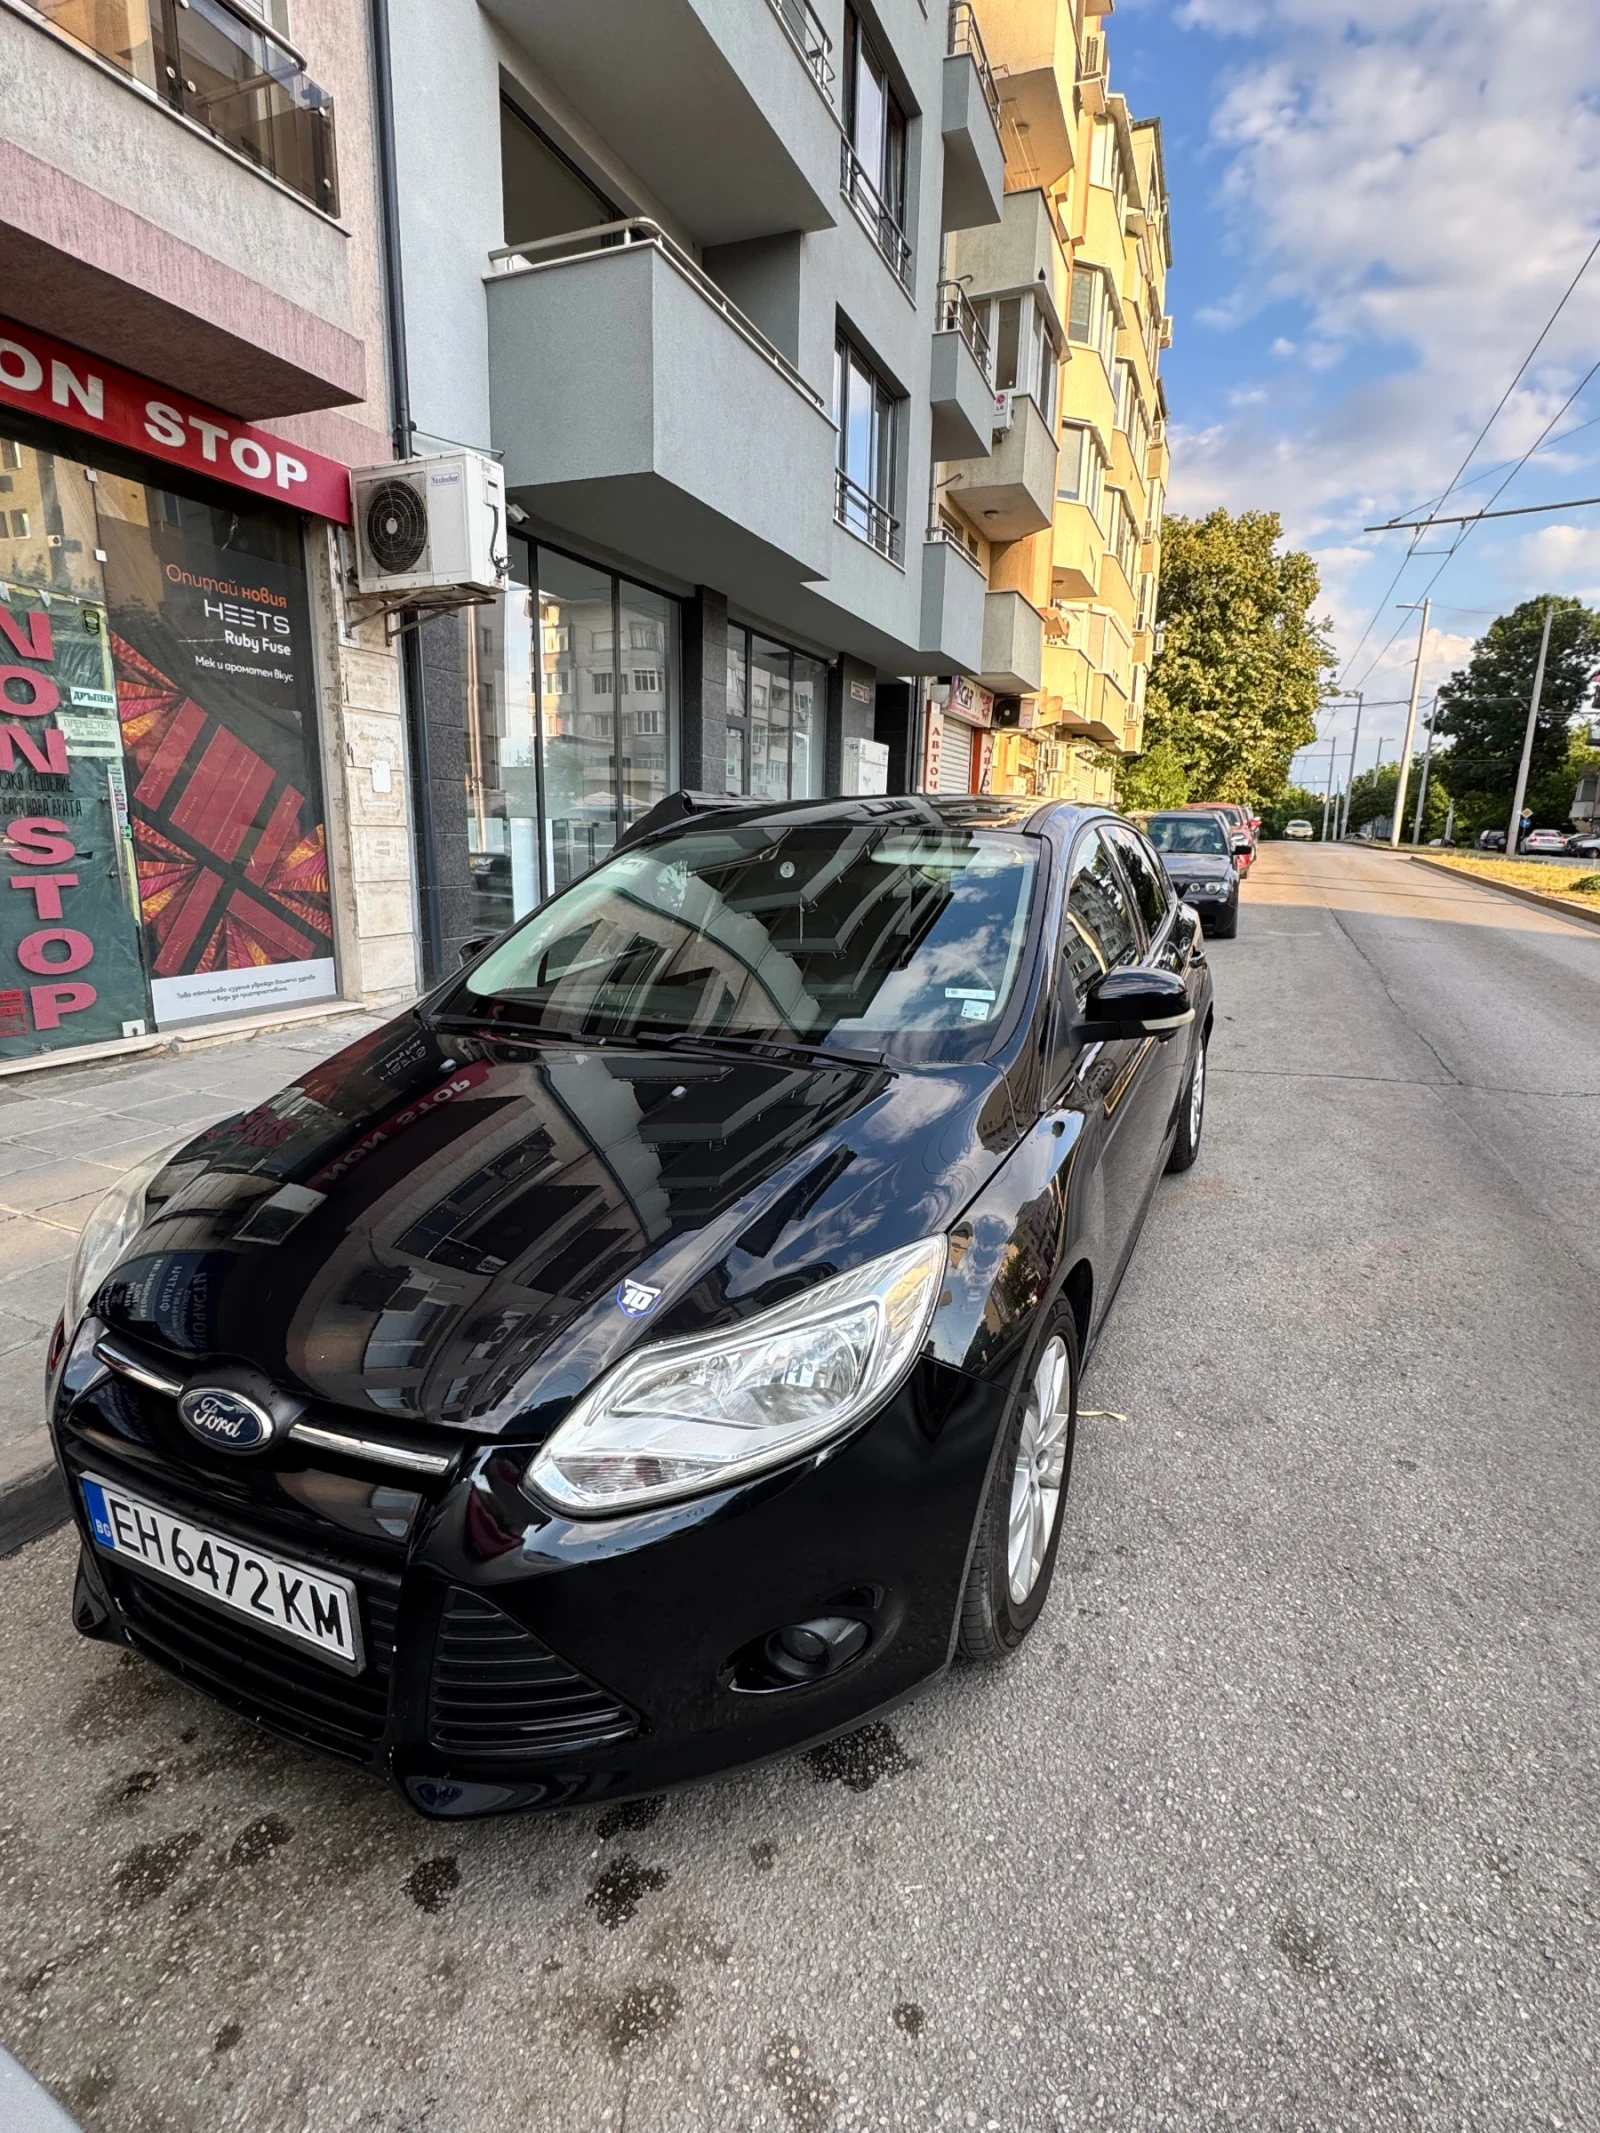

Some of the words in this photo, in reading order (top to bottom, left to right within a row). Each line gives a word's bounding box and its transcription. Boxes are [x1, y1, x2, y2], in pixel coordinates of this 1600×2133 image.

[144, 401, 308, 489] STOP
[166, 564, 238, 597] Опитай
[241, 587, 287, 608] новия
[204, 599, 290, 635] HEETS
[224, 630, 260, 654] Ruby
[262, 638, 292, 656] Fuse
[195, 655, 216, 669] Мек
[217, 661, 223, 669] и
[224, 662, 273, 677] ароматен
[274, 668, 294, 684] вкус
[7, 817, 97, 1030] STOP
[622, 1289, 653, 1310] 10
[194, 1397, 245, 1438] Ford
[95, 1519, 112, 1538] BG
